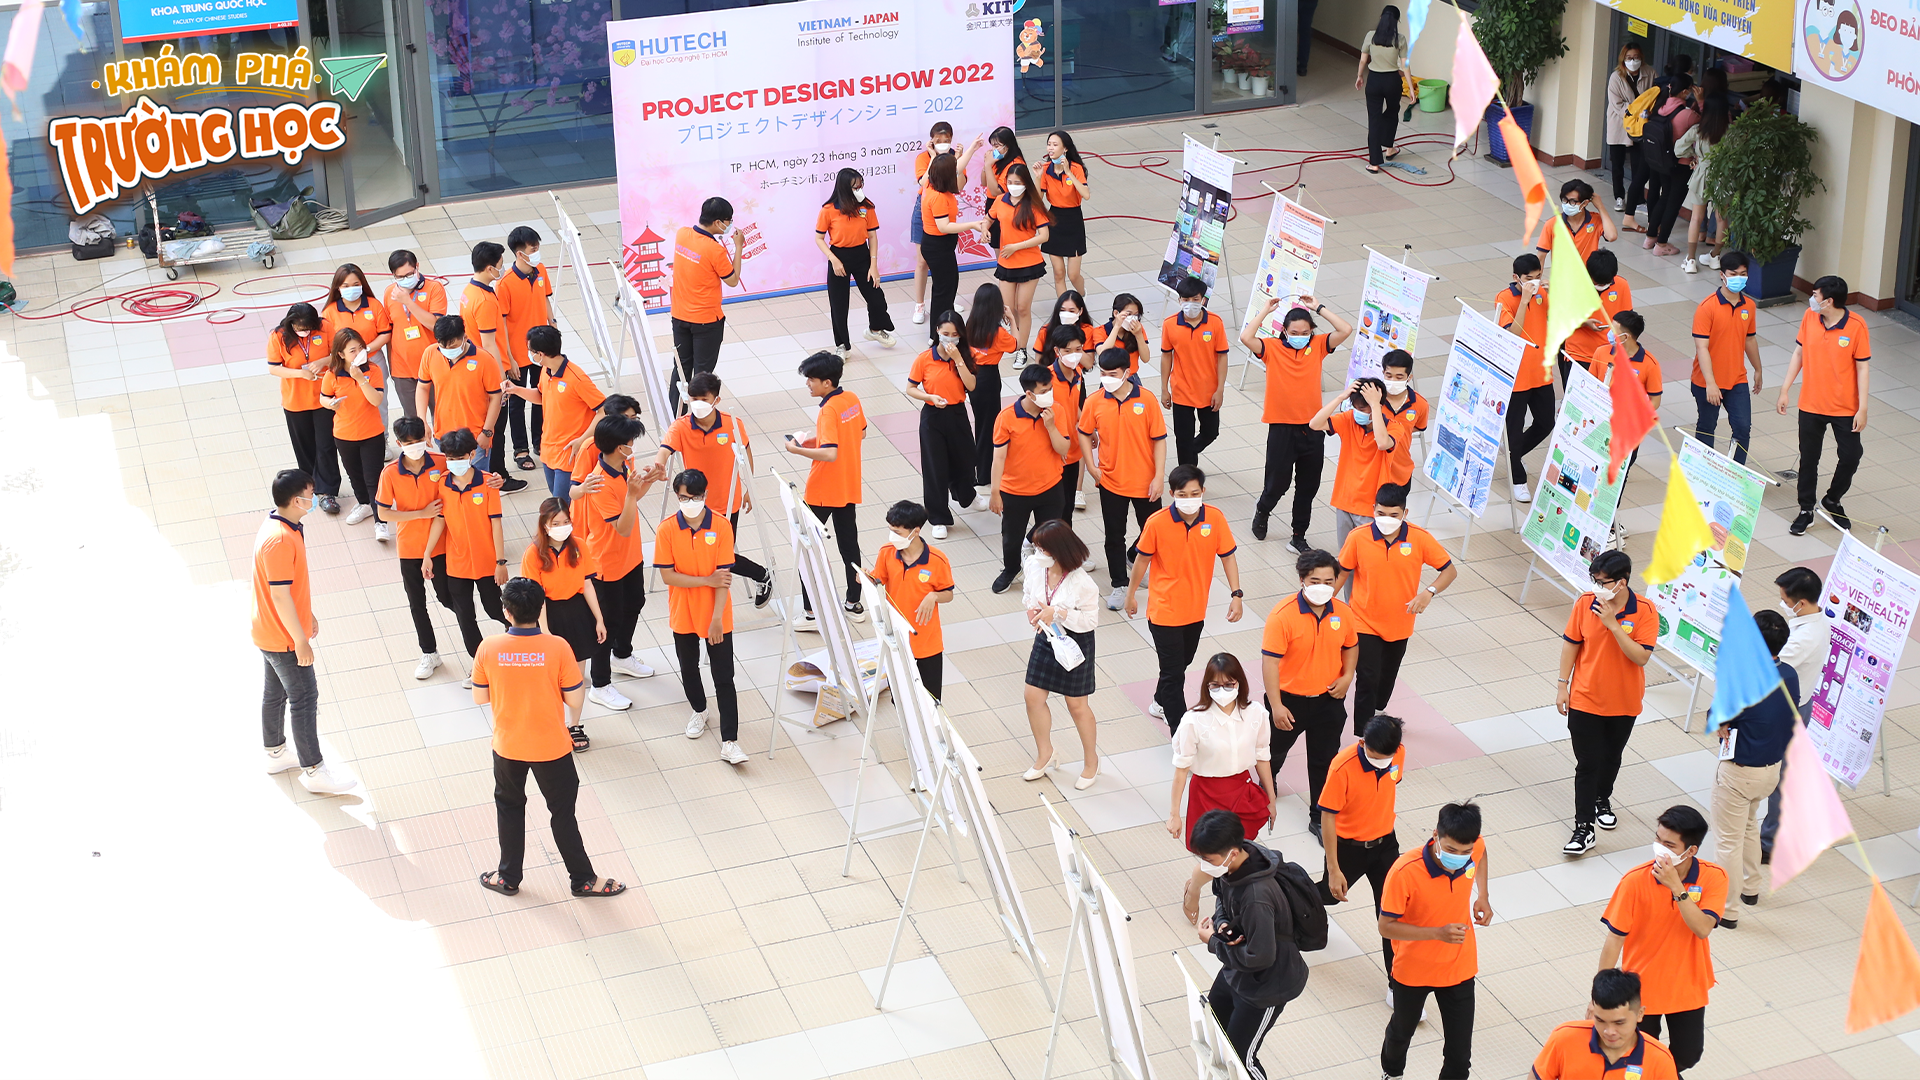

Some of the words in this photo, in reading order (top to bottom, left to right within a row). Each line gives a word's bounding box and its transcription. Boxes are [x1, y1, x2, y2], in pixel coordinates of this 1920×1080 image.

[151, 7, 179, 17] KHOA
[181, 2, 214, 14] TRUNG
[982, 1, 1012, 15] KIT
[1703, 3, 1718, 22] VỪA
[798, 16, 851, 32] VIETNAM
[862, 11, 899, 25] JAPAN
[966, 18, 1012, 31] 金沢工業大学
[1870, 8, 1898, 31] ĐEO
[1900, 17, 1920, 41] BẢ
[640, 30, 727, 56] HUTECH
[798, 35, 830, 47] Institute
[835, 32, 844, 43] of
[849, 29, 899, 42] Technology
[653, 57, 664, 65] học
[666, 55, 683, 64] Công
[642, 89, 758, 121] PROJECT
[764, 78, 855, 107] DESIGN
[860, 69, 934, 95] SHOW
[939, 62, 994, 85] 2022
[678, 103, 918, 144] プロジェクトデザインショー
[924, 95, 964, 114] 2022
[730, 162, 745, 173] TP.
[749, 158, 779, 172] HCM,
[783, 156, 808, 168] ngày
[811, 152, 825, 164] 23
[829, 150, 857, 162] tháng
[861, 147, 867, 157] 3
[871, 146, 892, 157] năm
[895, 140, 922, 153] 2022
[1707, 449, 1715, 458] KIT
[1876, 568, 1884, 576] KIT
[1849, 586, 1907, 629] VIETHEALTH
[498, 652, 545, 662] HUTECH
